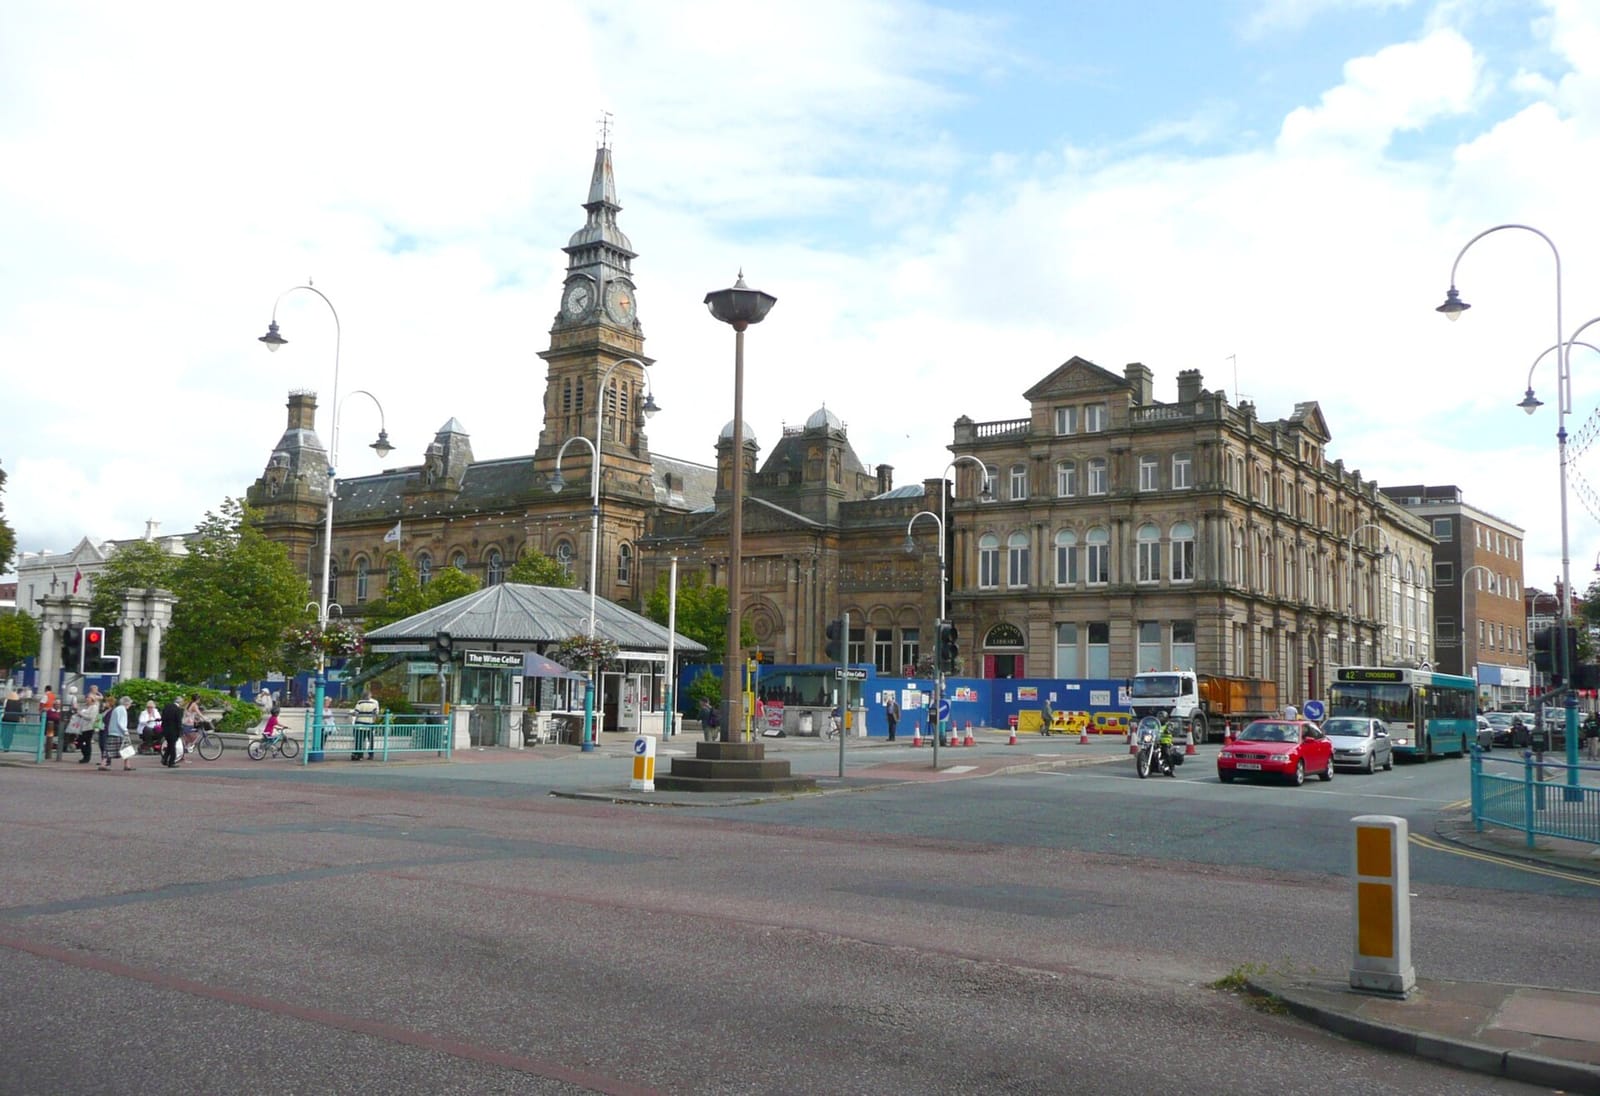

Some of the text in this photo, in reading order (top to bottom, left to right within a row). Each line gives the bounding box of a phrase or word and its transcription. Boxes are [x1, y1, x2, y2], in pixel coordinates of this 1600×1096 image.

[469, 653, 521, 665] The Wine Cellar
